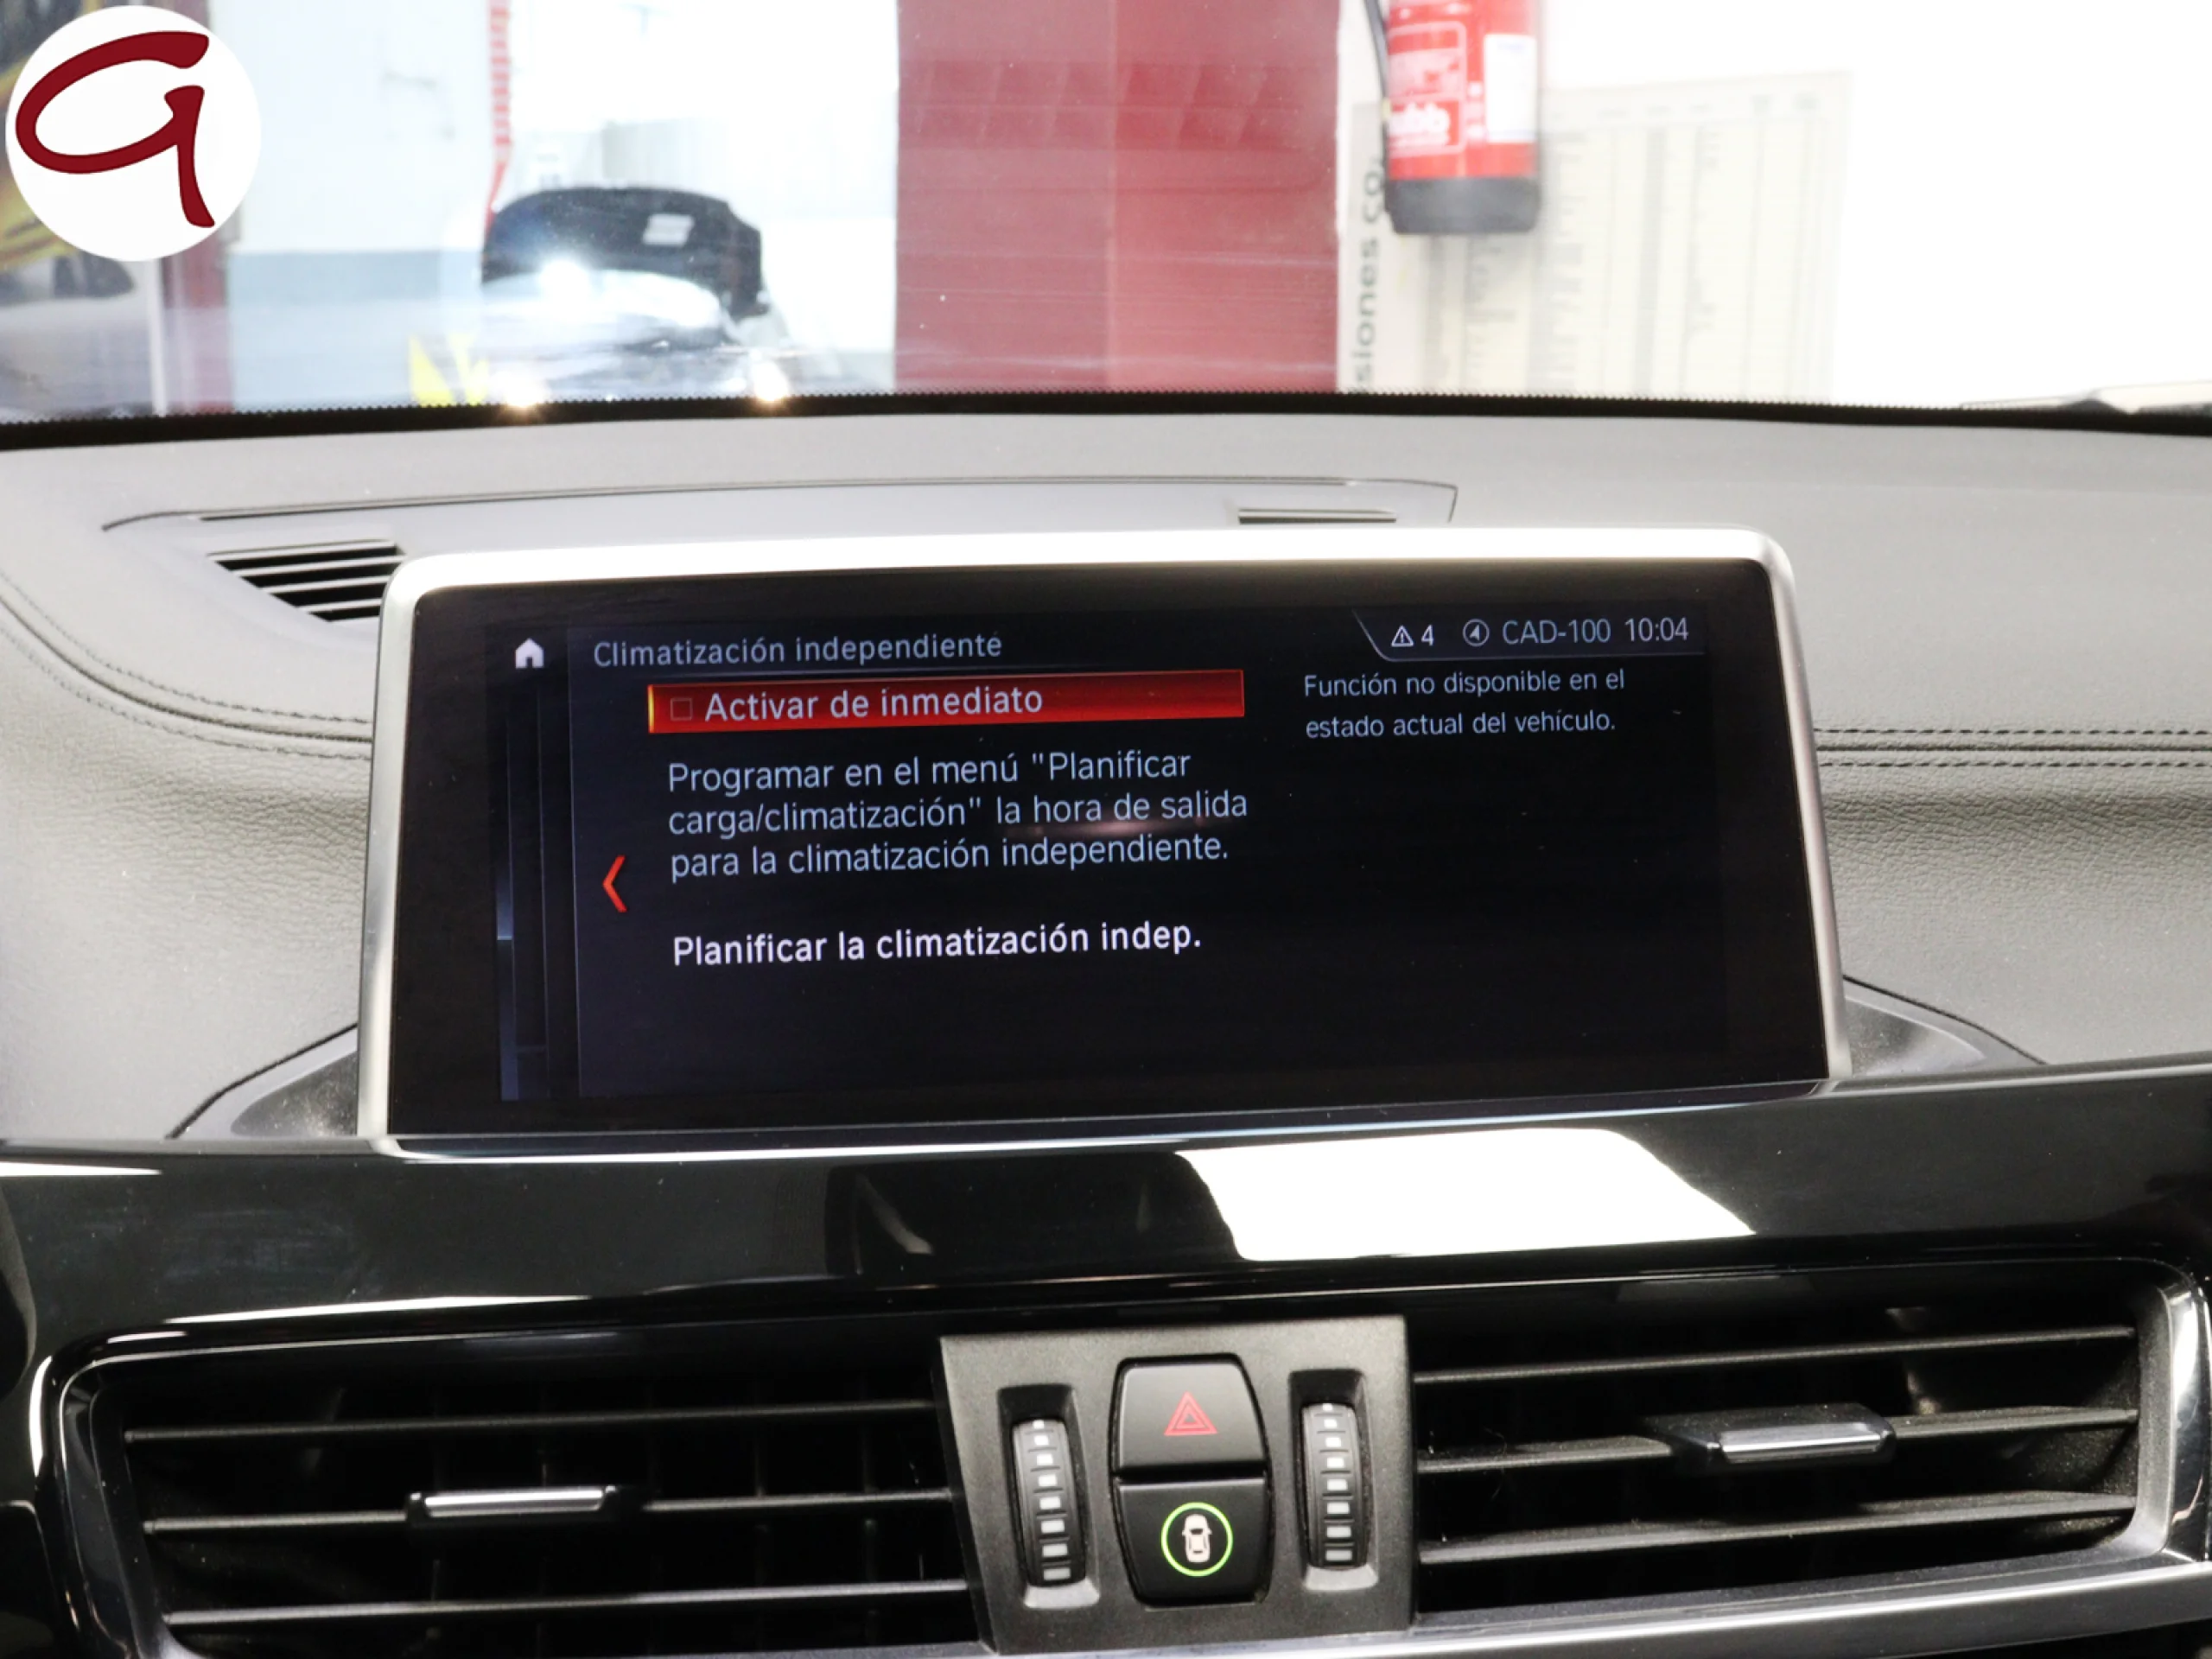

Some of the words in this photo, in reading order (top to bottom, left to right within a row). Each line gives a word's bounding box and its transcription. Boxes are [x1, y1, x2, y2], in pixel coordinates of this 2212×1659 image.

[1421, 625, 1434, 646] 4
[1503, 619, 1611, 645] CAD-100
[1625, 617, 1689, 642] 10:04
[594, 637, 785, 667] Climatización
[797, 633, 1002, 667] independiente
[1304, 672, 1397, 697] Función
[1407, 677, 1435, 695] no
[1444, 670, 1561, 697] disponible
[1570, 673, 1598, 691] en
[1605, 669, 1624, 690] el
[704, 692, 819, 722] Activar
[830, 689, 869, 719] de
[882, 685, 1043, 717] inmediato
[1306, 715, 1385, 739] estado
[1394, 712, 1463, 736] actual
[1472, 711, 1506, 734] del
[1515, 709, 1616, 733] vehículo.
[668, 762, 835, 798] Programar
[845, 764, 882, 787] en
[893, 755, 919, 786] el
[932, 753, 1019, 785] menú
[1032, 750, 1192, 781] "Planificar
[668, 796, 982, 840] carga/climatización"
[996, 795, 1021, 825] la
[1033, 794, 1102, 823] hora
[1113, 792, 1151, 821] de
[1161, 789, 1248, 819] salida
[672, 852, 740, 884] para
[753, 845, 777, 875] la
[788, 837, 989, 874] climatización
[1002, 832, 1229, 872] independiente.
[673, 932, 828, 967] Planificar
[838, 930, 865, 961] la
[875, 921, 1089, 960] climatización
[1102, 919, 1201, 955] indep.
